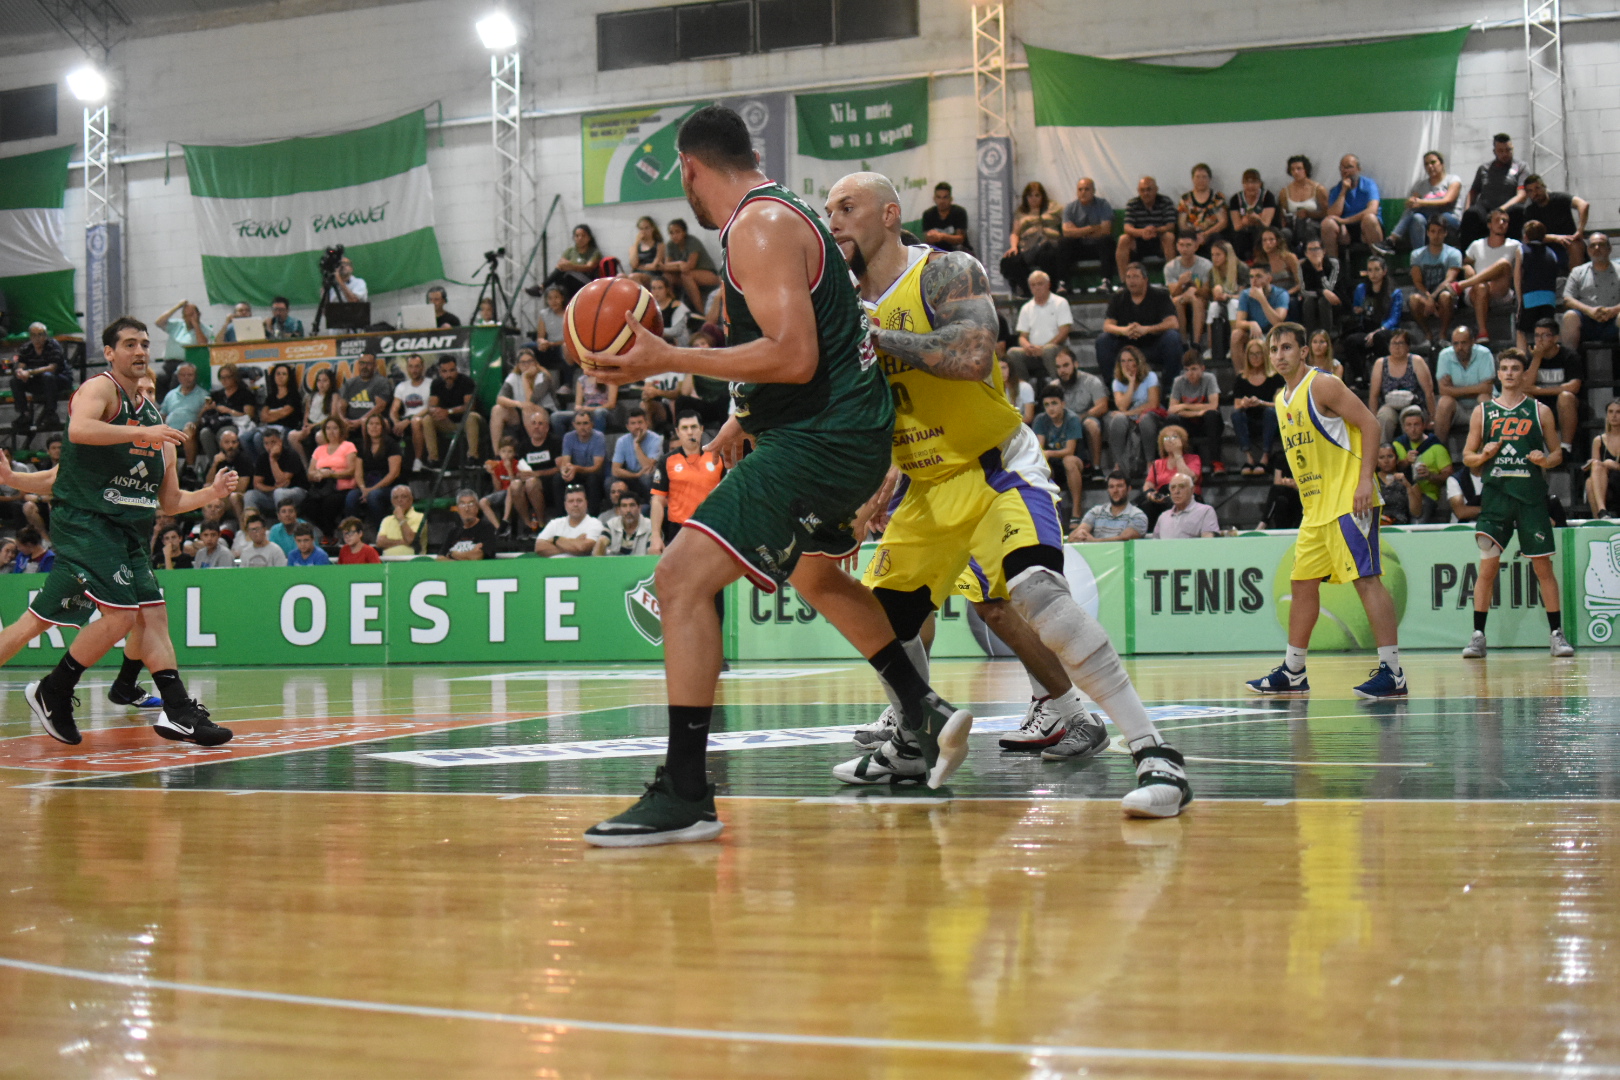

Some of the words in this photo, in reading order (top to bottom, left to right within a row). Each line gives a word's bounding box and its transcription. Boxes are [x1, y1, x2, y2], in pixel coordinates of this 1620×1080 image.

[830, 102, 844, 122] Ni
[232, 216, 292, 239] FERRO
[311, 201, 390, 233] BASQUET
[395, 335, 457, 351] GIANT
[893, 433, 915, 447] SAN
[915, 426, 945, 442] JUAN
[1490, 417, 1533, 437] FCO
[1296, 449, 1307, 469] 5
[109, 475, 159, 493] AISPLAC
[1143, 567, 1265, 616] TENIS
[280, 576, 580, 646] OESTE
